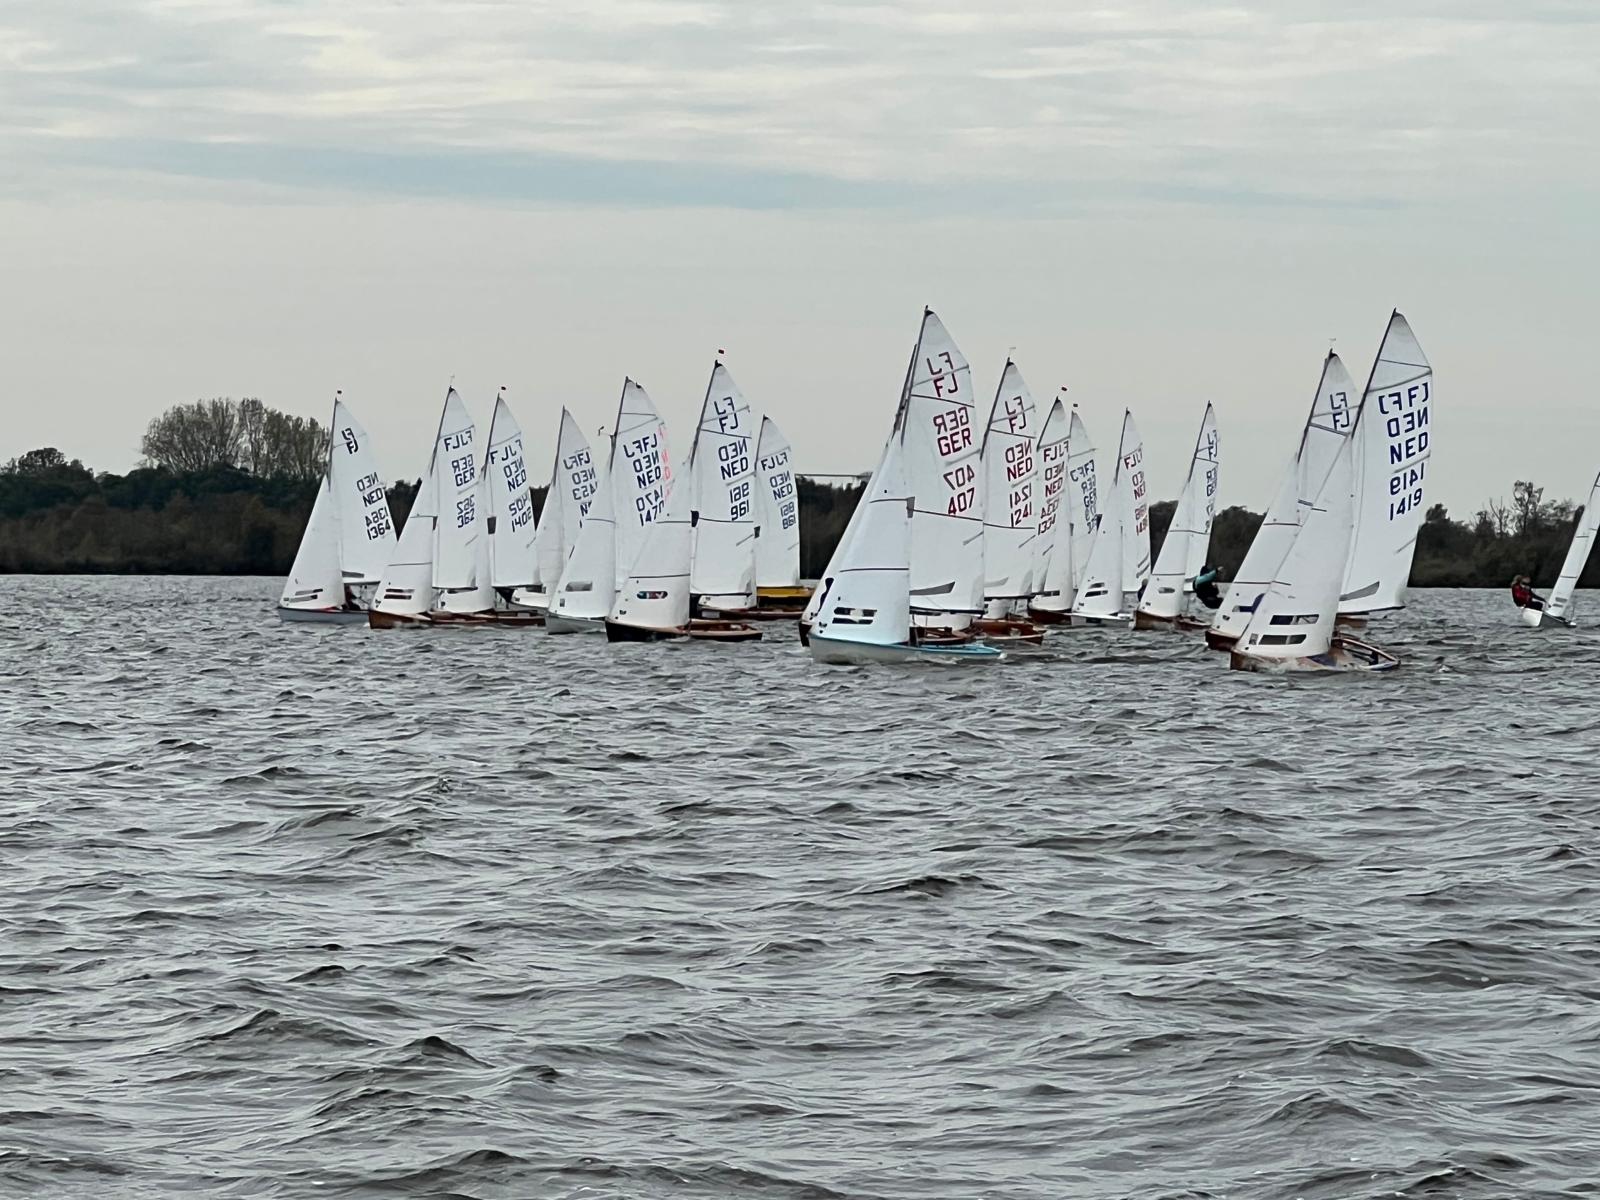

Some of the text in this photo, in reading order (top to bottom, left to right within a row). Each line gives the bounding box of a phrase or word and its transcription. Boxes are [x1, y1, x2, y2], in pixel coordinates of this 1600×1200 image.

[933, 371, 958, 398] FJ
[1408, 382, 1429, 408] FJ
[719, 412, 739, 433] FJ
[1008, 411, 1027, 434] FJ
[1333, 409, 1350, 430] FJ
[444, 435, 460, 452] FJ
[642, 433, 658, 453] FJ
[937, 427, 972, 457] GER
[1389, 431, 1429, 465] NED
[489, 446, 509, 465] FJ
[577, 451, 591, 466] FJ
[760, 456, 776, 471] FJ
[1043, 446, 1058, 462] FJ
[1123, 454, 1138, 470] FJ
[455, 467, 475, 487] GER
[636, 465, 662, 489] NED
[720, 456, 749, 480] NED
[1006, 457, 1033, 482] NED
[1084, 459, 1095, 476] FJ
[507, 469, 527, 492] NED
[1045, 477, 1063, 497] NED
[362, 488, 384, 508] NED
[773, 483, 793, 501] NED
[948, 486, 975, 516] 407
[730, 499, 750, 522] 961
[1010, 501, 1032, 528] 1241
[1390, 487, 1423, 521] 1419
[457, 508, 475, 528] 362
[511, 506, 533, 533] 1402
[367, 519, 391, 541] 1364
